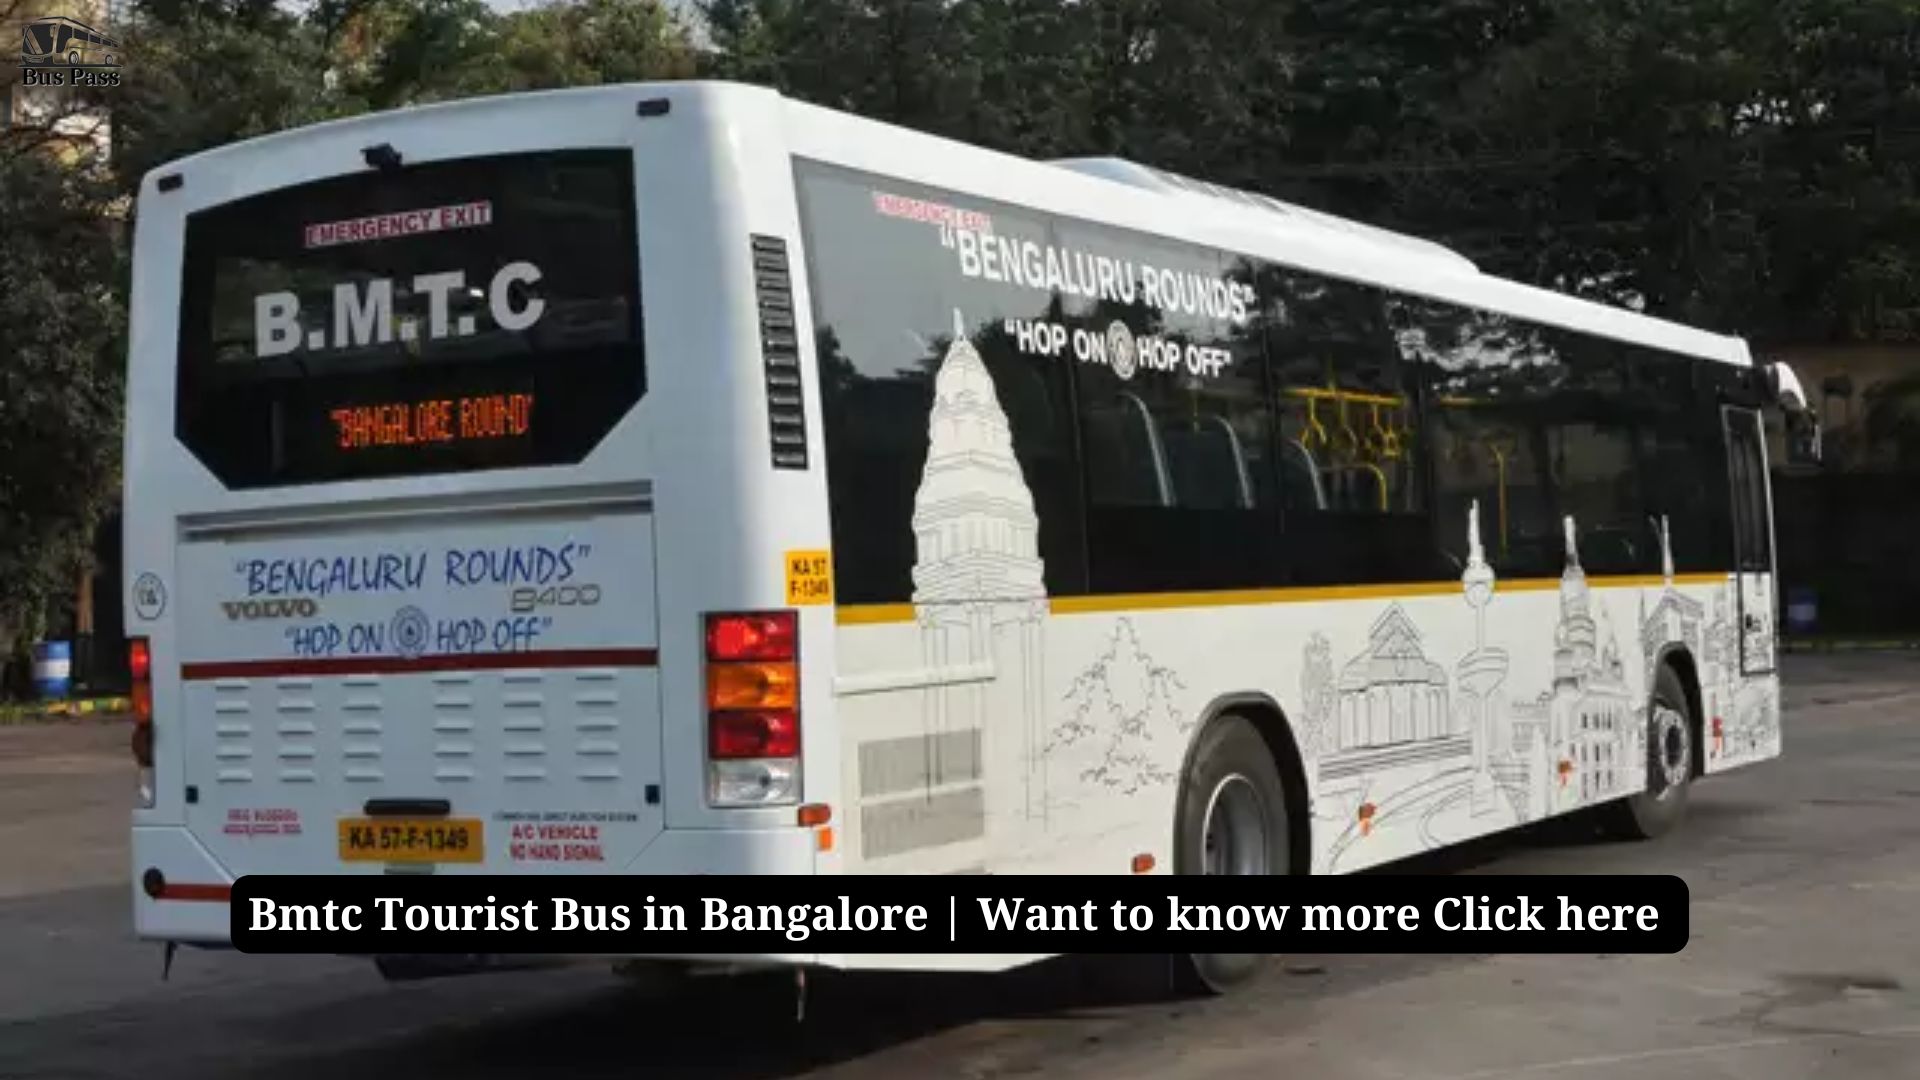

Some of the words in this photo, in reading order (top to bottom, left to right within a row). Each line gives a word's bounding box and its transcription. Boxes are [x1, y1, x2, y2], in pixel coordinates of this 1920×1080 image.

[304, 211, 433, 248] EMERGENCY
[440, 201, 492, 228] EXIT
[1073, 328, 1109, 366] ON
[1137, 336, 1180, 371] HOP
[791, 558, 811, 576] KA
[812, 557, 827, 576] 57
[222, 598, 318, 621] VOLVO
[348, 622, 385, 653] ON
[437, 617, 486, 655] HOP
[349, 826, 375, 849] KA
[380, 826, 469, 851] 57-F-1349
[538, 824, 598, 840] VEHICLE
[510, 844, 526, 860] NO
[528, 844, 560, 861] HAND
[563, 844, 605, 861] SIGNAL
